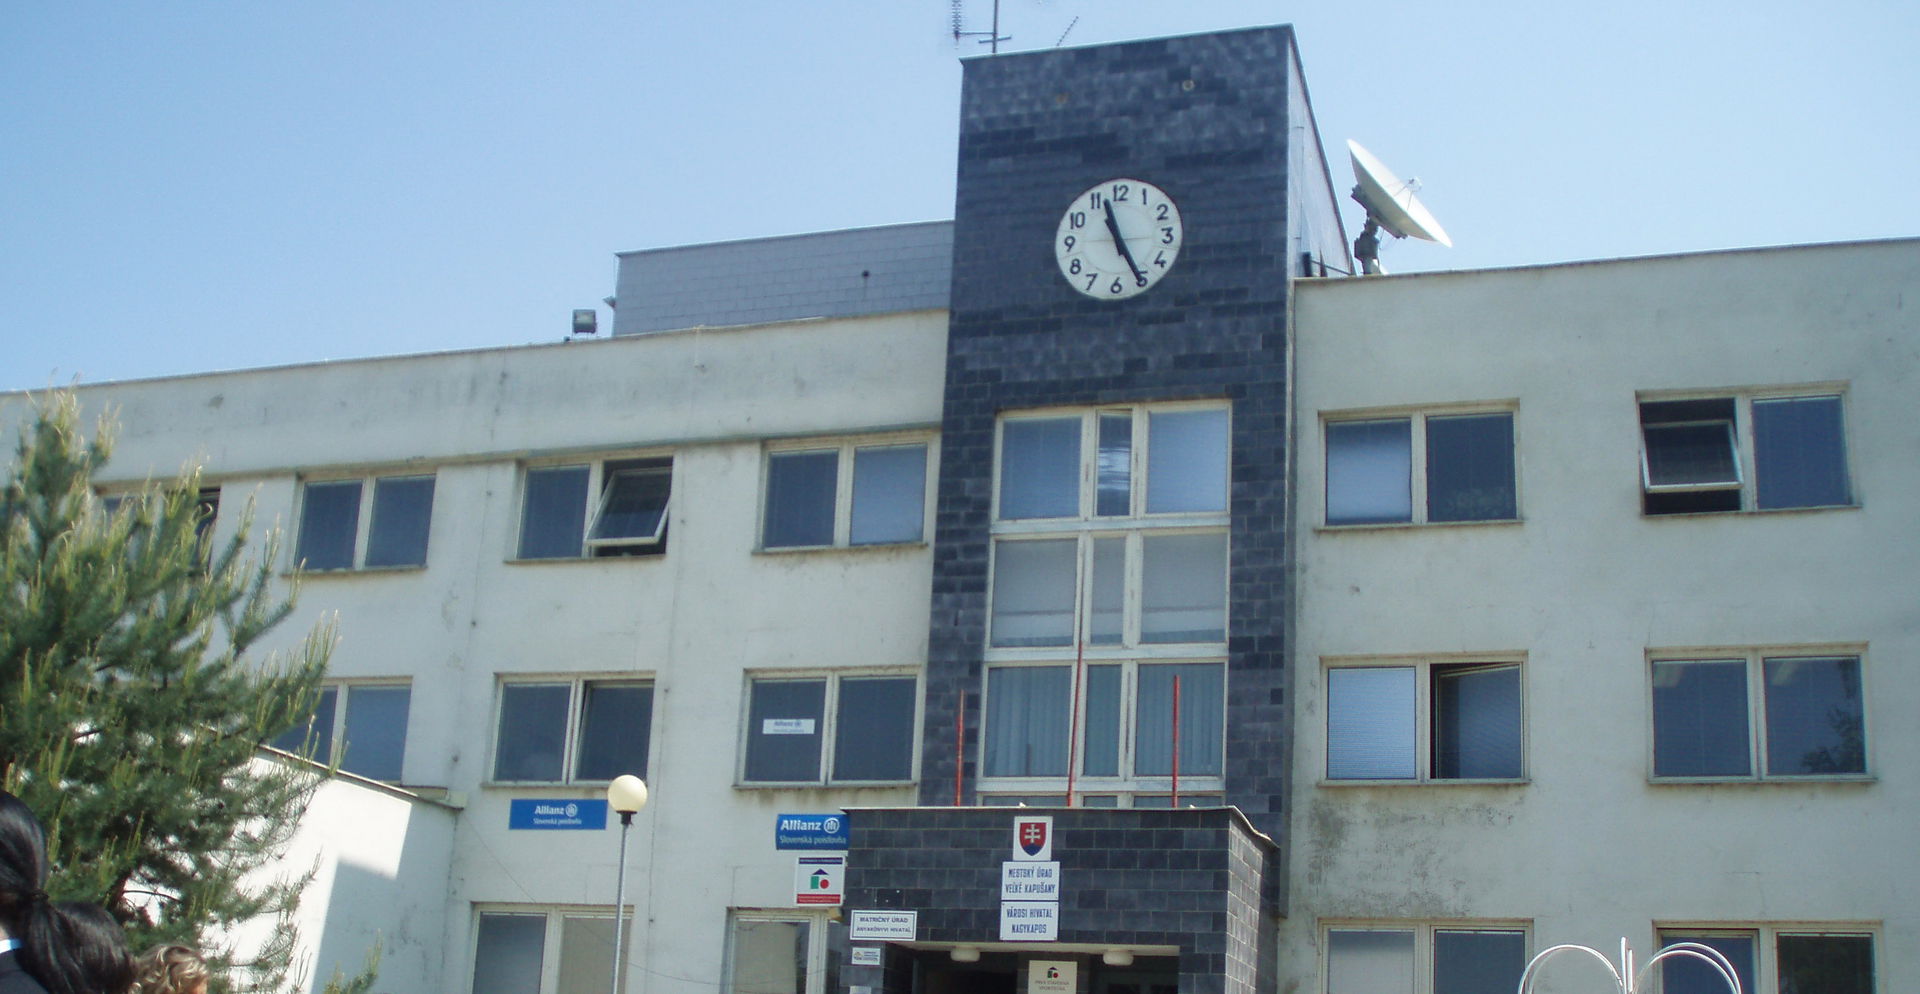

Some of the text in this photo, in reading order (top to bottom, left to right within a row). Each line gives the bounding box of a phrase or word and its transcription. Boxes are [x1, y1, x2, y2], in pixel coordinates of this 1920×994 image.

[1090, 192, 1101, 210] 11
[1113, 184, 1129, 202] 12
[1142, 188, 1147, 206] 1
[1070, 211, 1086, 230] 10
[1156, 203, 1169, 221] 2
[1064, 235, 1076, 253] 9
[1161, 226, 1174, 244] 3
[1069, 258, 1082, 275] 8
[1154, 250, 1167, 268] 4
[1085, 273, 1098, 291] 7
[1110, 276, 1123, 294] 6
[1136, 270, 1149, 287] 5
[534, 805, 565, 815] Allianz
[780, 819, 822, 831] Allianz
[1008, 866, 1052, 878] MESTSKÝ ÚRAD
[1024, 882, 1056, 893] KAPUŠANY
[1006, 906, 1052, 918] VÁROSI HIVATAL
[1011, 924, 1047, 933] NAGYKAPOS
